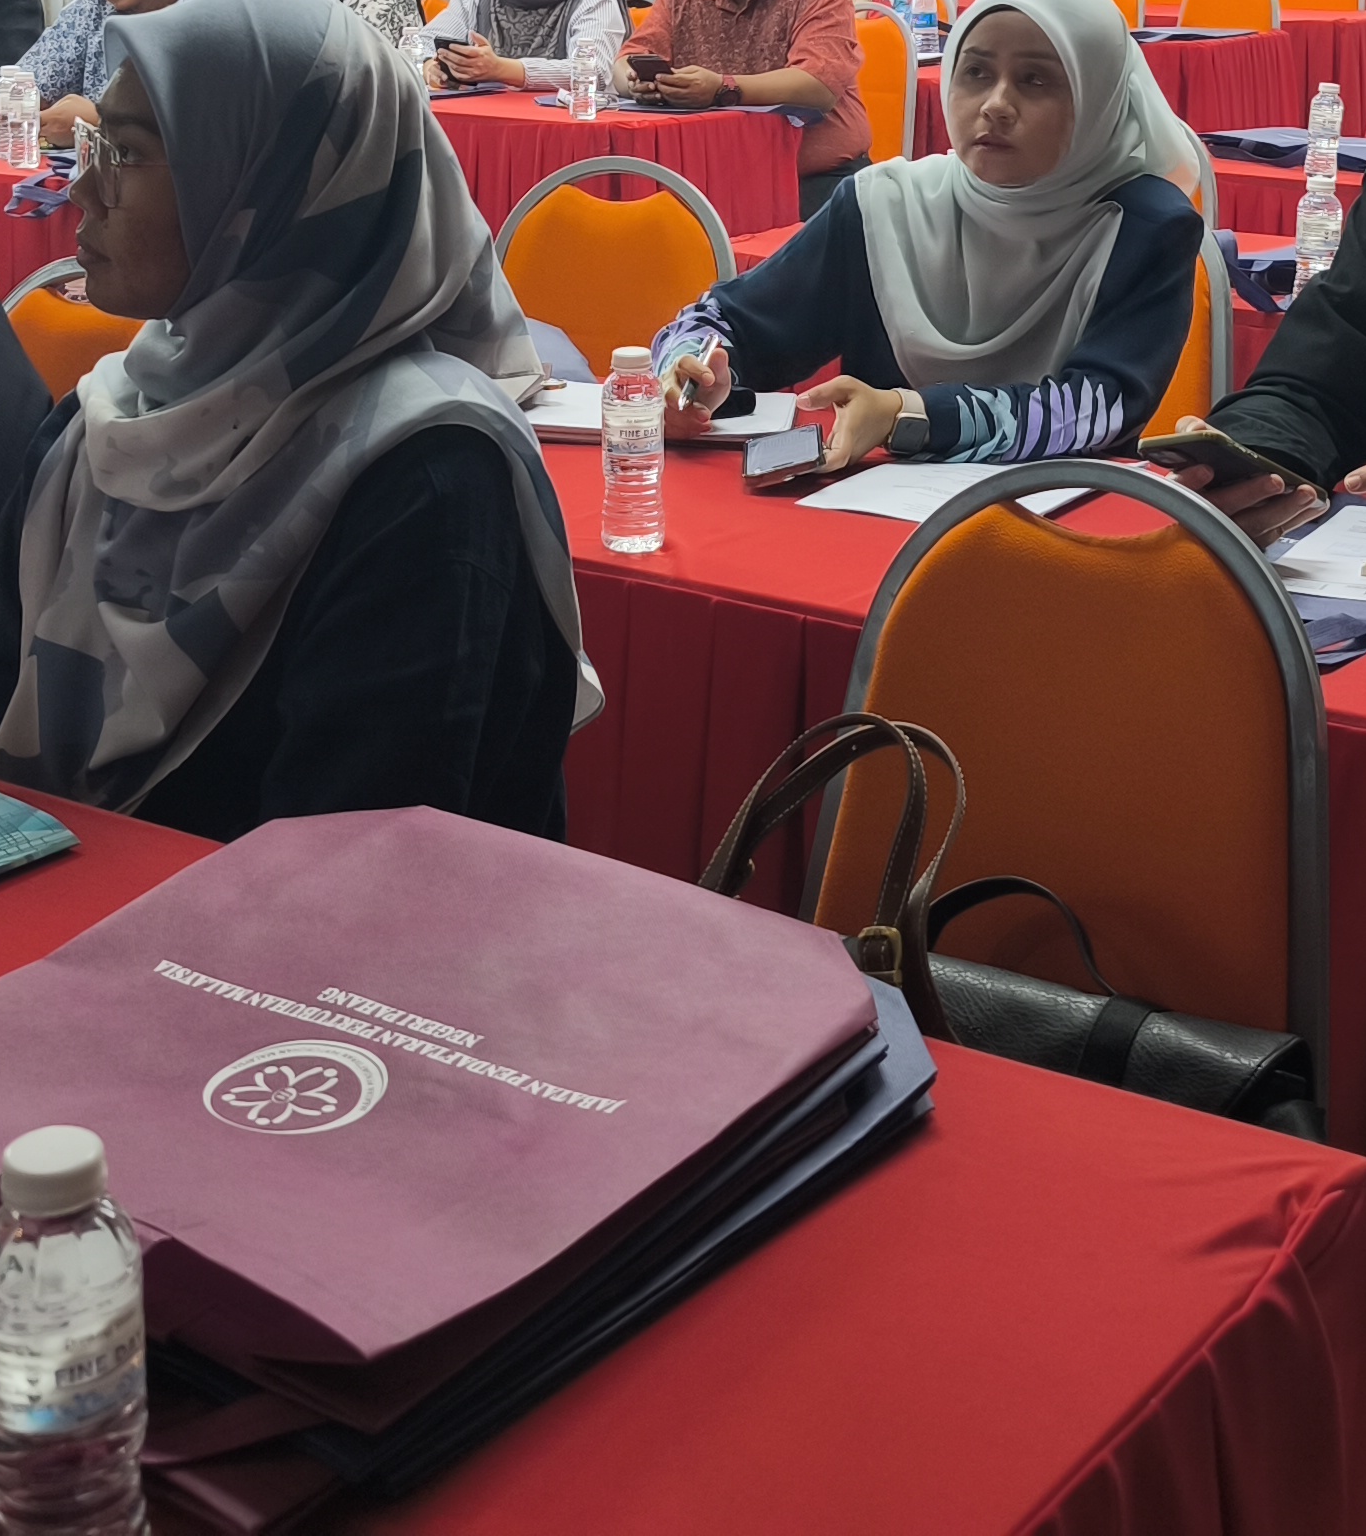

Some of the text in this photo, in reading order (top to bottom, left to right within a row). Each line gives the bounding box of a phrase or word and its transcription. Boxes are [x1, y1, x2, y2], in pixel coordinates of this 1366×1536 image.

[153, 959, 255, 1002] MALAYSIA
[243, 991, 384, 1040] PERTUBUHAN
[317, 987, 485, 1049] NEGERI PAHANG
[377, 1029, 531, 1088] PENDAFTARAN
[523, 1079, 628, 1114] JABATAN
